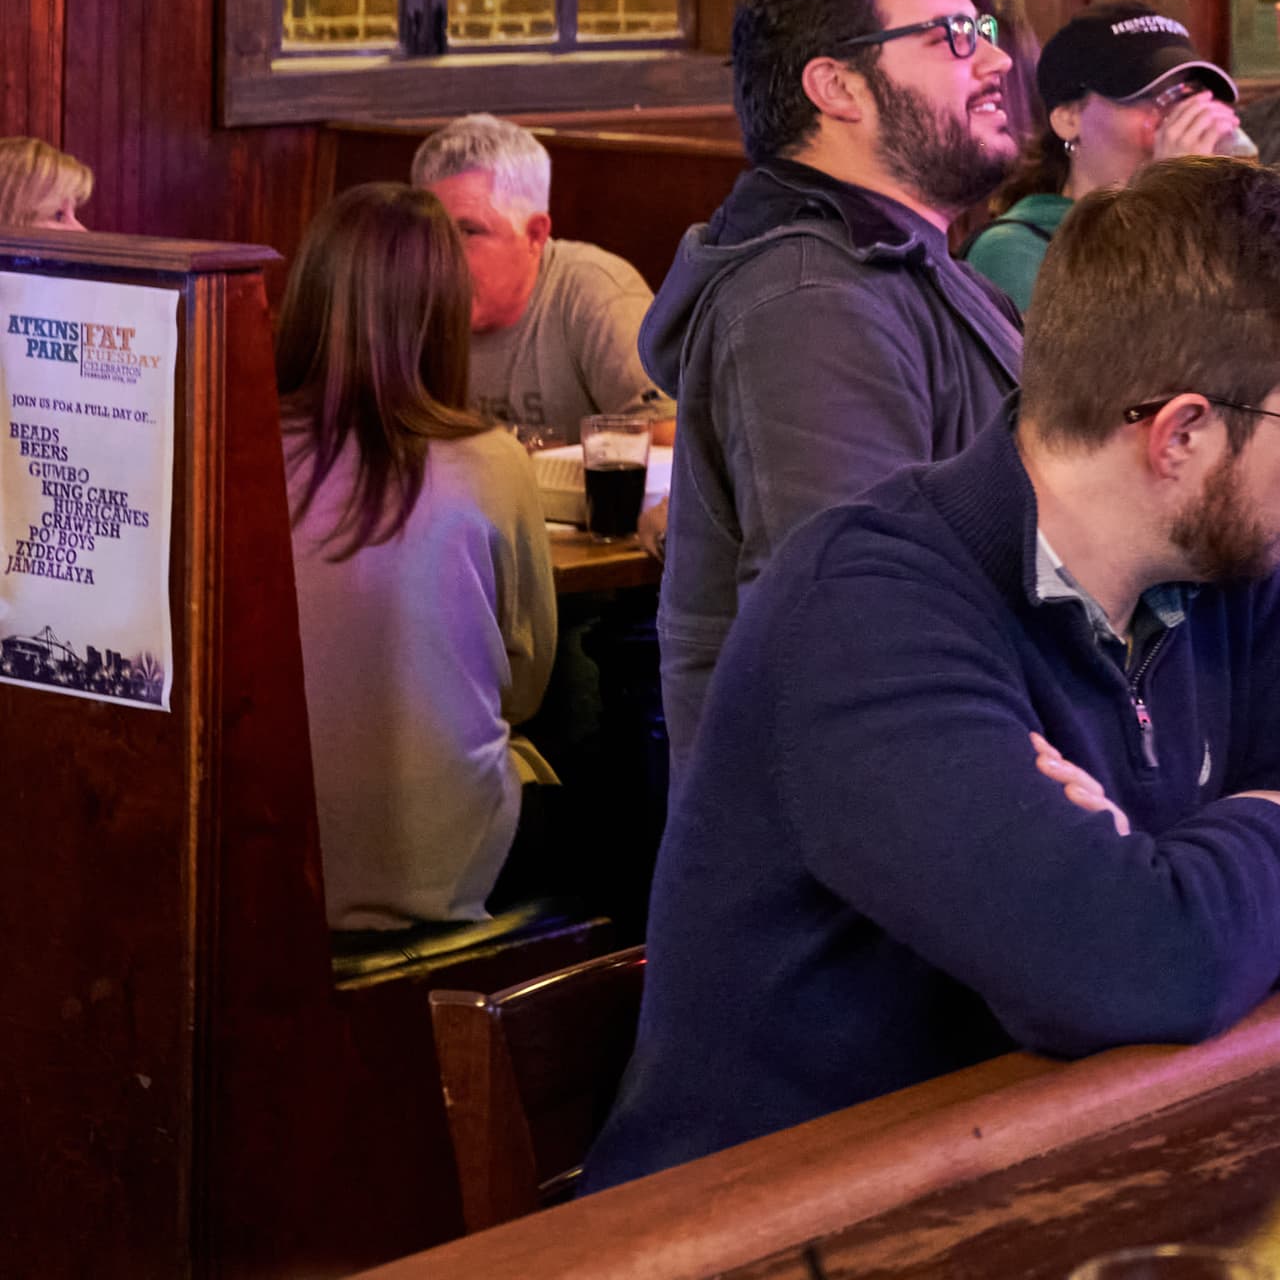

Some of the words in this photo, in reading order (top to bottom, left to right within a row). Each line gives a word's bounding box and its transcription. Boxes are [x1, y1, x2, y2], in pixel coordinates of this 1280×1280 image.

[7, 314, 79, 342] ATKINS
[84, 323, 136, 351] FAT
[25, 338, 78, 363] PARK
[83, 347, 161, 369] TUESDAY
[12, 394, 36, 408] JOIN
[39, 397, 50, 407] US
[53, 399, 73, 413] FOR
[75, 402, 82, 414] A
[84, 404, 110, 418] FULL
[112, 407, 132, 420] DAY
[9, 422, 60, 443] BEADS
[20, 440, 69, 462] BEERS
[29, 461, 90, 484] GUMBO
[42, 480, 83, 500] KING
[87, 488, 128, 508] CAKE
[53, 497, 149, 527] HURRICANES
[29, 525, 55, 543] PO'
[59, 531, 95, 551] BOYS
[42, 512, 121, 539] CRAWFISH
[16, 540, 77, 564] ZYDECO
[5, 555, 95, 585] JAMBALAYA
